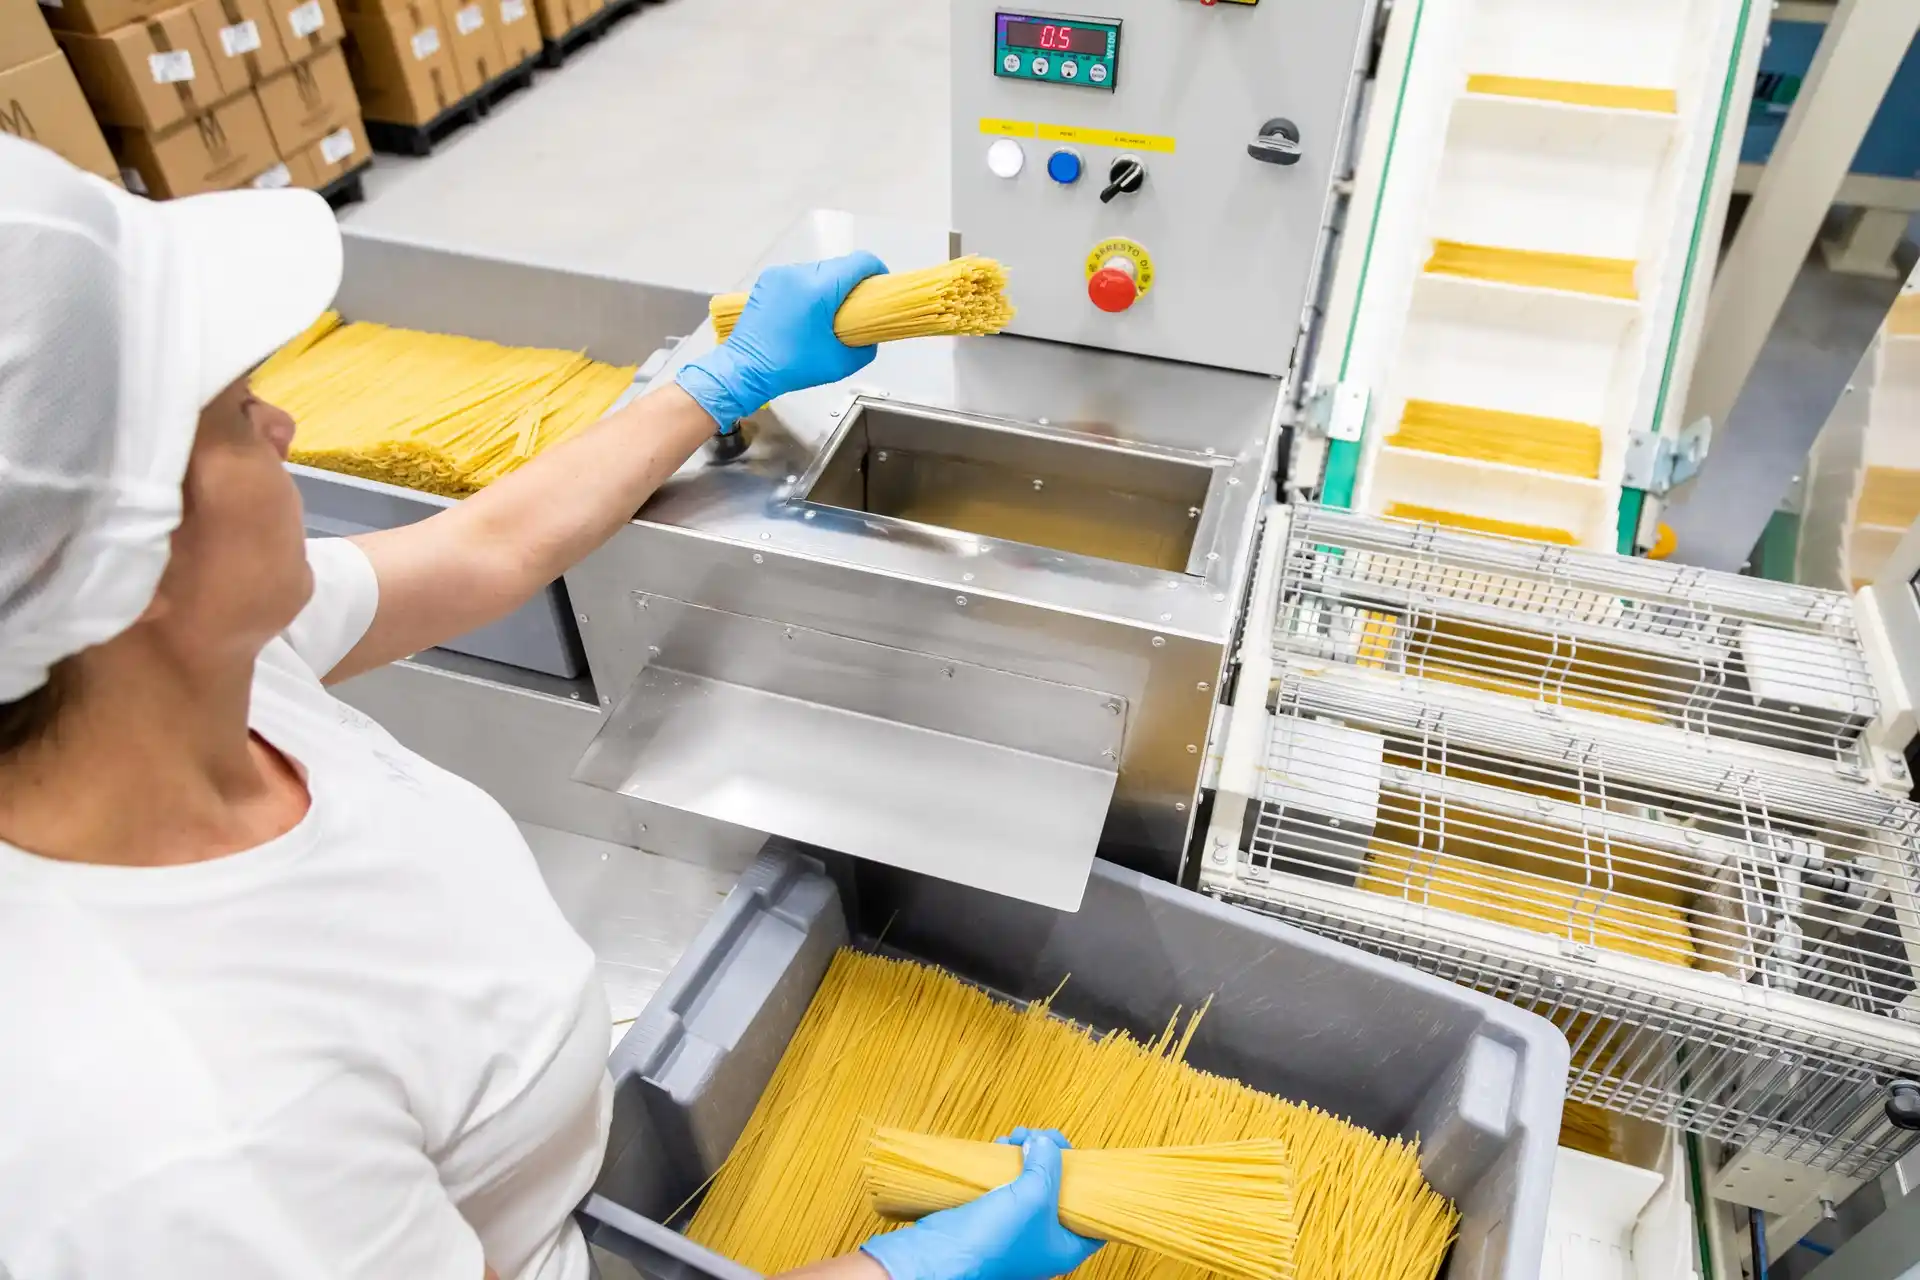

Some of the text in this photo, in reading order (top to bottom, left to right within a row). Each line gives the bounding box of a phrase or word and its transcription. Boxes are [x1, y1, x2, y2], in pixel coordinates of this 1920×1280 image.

[1040, 25, 1071, 49] 0.5
[1107, 31, 1117, 59] W100
[1094, 243, 1149, 270] ARRESTO DI
